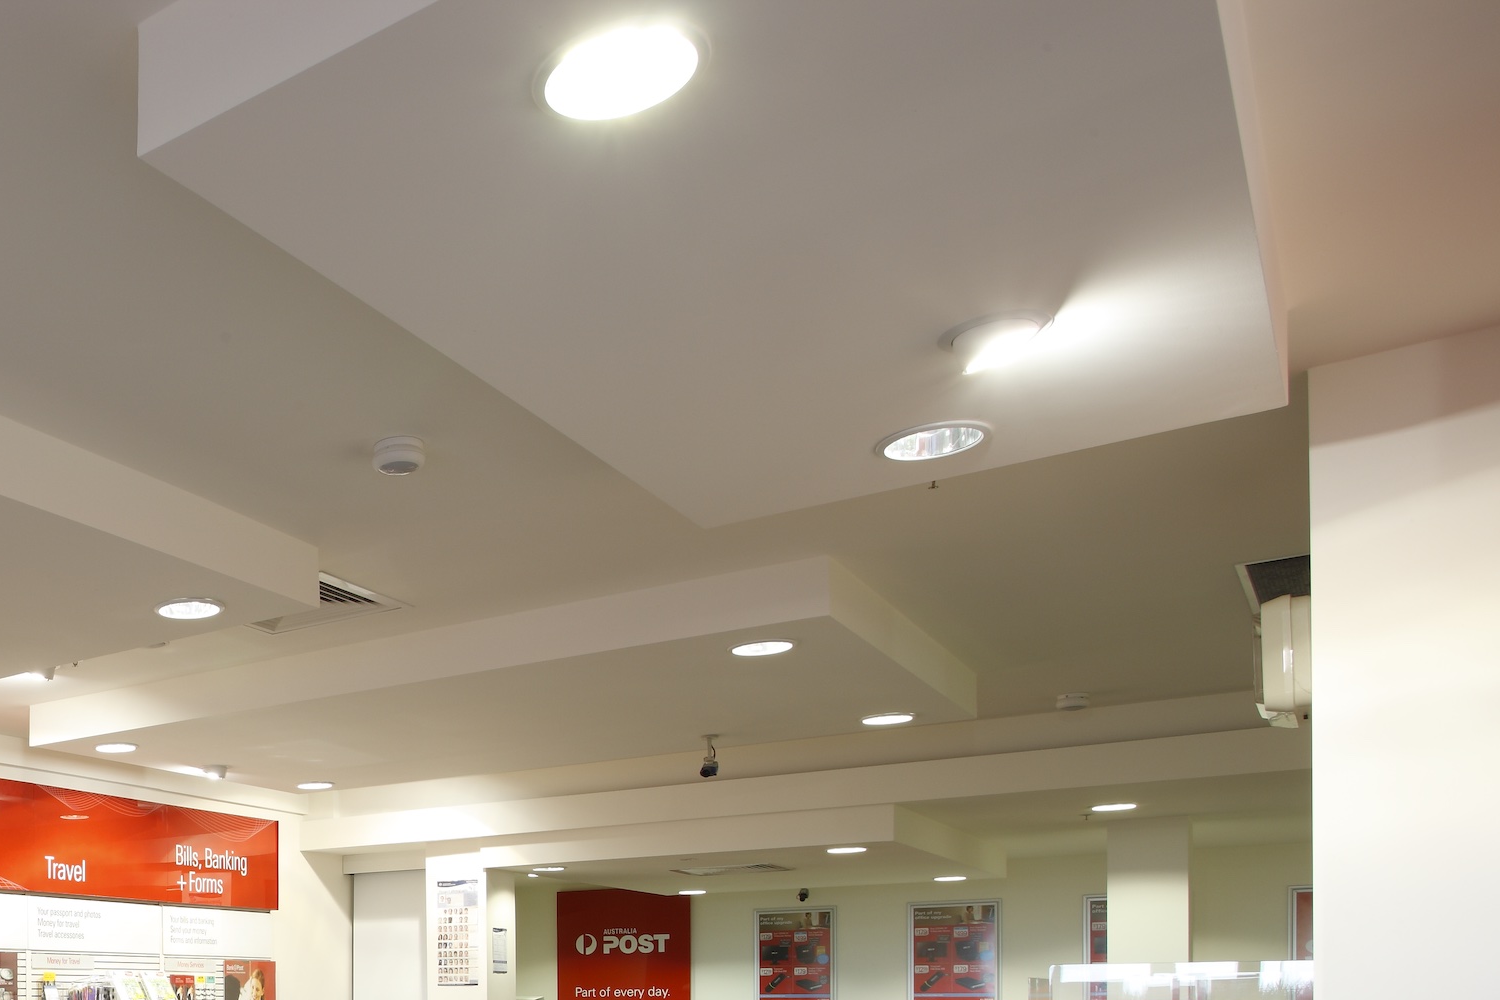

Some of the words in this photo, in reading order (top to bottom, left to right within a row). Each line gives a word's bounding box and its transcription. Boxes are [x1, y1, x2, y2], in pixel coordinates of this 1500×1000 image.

[175, 843, 201, 870] Bills,
[204, 847, 248, 877] Banking
[44, 854, 86, 883] Travel
[189, 870, 223, 895] Forms
[37, 907, 48, 916] Your
[49, 908, 73, 920] passport
[73, 909, 83, 918] and
[84, 909, 101, 920] photos
[37, 918, 56, 929] Money
[56, 918, 64, 928] for
[65, 919, 80, 929] travel
[38, 929, 54, 938] Travel
[603, 927, 637, 935] AUSTRALIA
[603, 932, 670, 954] POST
[46, 957, 61, 966] Money
[68, 956, 80, 965] Travel
[575, 986, 597, 998] Part
[599, 986, 611, 998] of
[613, 988, 645, 1000] every
[647, 986, 671, 1000] day.
